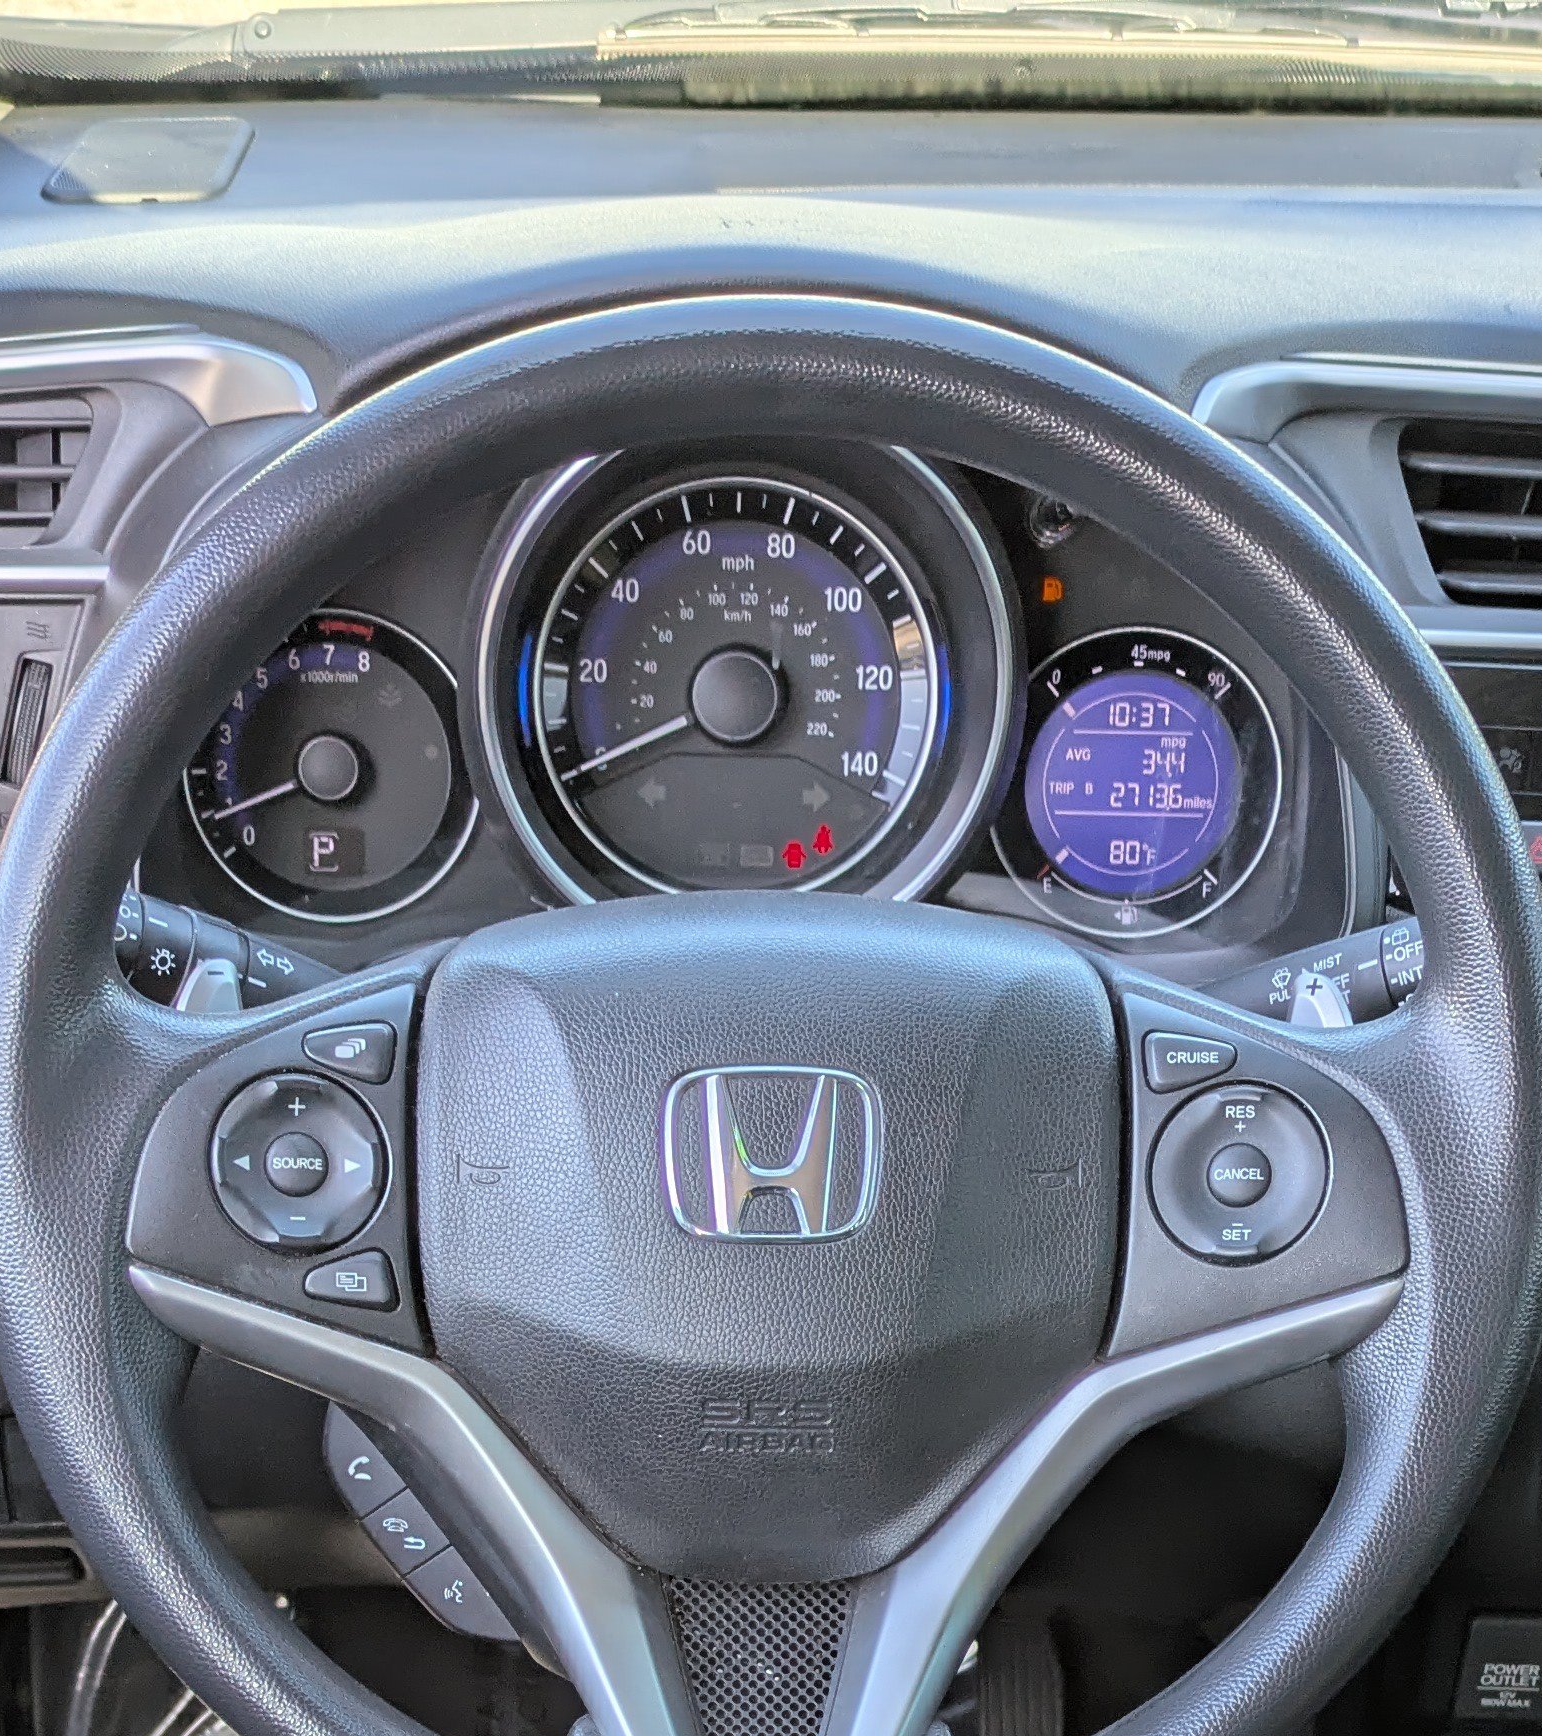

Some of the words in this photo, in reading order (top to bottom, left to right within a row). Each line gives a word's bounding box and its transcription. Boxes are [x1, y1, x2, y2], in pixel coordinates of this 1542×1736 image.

[682, 530, 711, 555] 60
[767, 533, 795, 559] 80
[722, 556, 755, 572] mph
[611, 578, 639, 603] 40
[708, 593, 726, 606] 100
[740, 592, 759, 606] 120
[824, 587, 862, 613] 100
[724, 609, 752, 622] km/h
[770, 604, 789, 617] 140
[658, 630, 673, 643] 60
[793, 623, 812, 636] 160
[288, 649, 300, 669] 6
[322, 644, 335, 665] 7
[358, 651, 370, 672] 8
[810, 654, 828, 667] 180
[580, 659, 608, 684] 20
[643, 661, 658, 674] 40
[256, 667, 268, 689] 5
[856, 665, 892, 691] 120
[1052, 669, 1062, 685] 0
[1208, 672, 1226, 687] 90
[232, 690, 244, 711] 4
[639, 695, 654, 708] 20
[815, 689, 835, 702] 200
[1109, 702, 1170, 728] 10:37
[219, 724, 231, 745] 3
[807, 722, 827, 735] 220
[1160, 737, 1187, 750] mpg
[1066, 748, 1091, 762] AVG
[216, 760, 228, 781] 2
[841, 751, 878, 777] 140
[1049, 781, 1075, 796] TRIP
[243, 825, 256, 846] 0
[312, 835, 335, 867] P
[1043, 877, 1053, 894] E
[1202, 882, 1212, 899] F
[1393, 940, 1424, 962] OFF
[1313, 953, 1343, 973] MIST
[1397, 965, 1424, 986] INT
[1166, 1052, 1219, 1064] CRUISE
[1225, 1105, 1255, 1119] RES
[272, 1157, 322, 1170] SOURCE
[1214, 1168, 1264, 1180] CANCEL
[1221, 1229, 1252, 1241] SET
[1484, 1663, 1540, 1676] POWER
[1480, 1675, 1540, 1686] OUTLET
